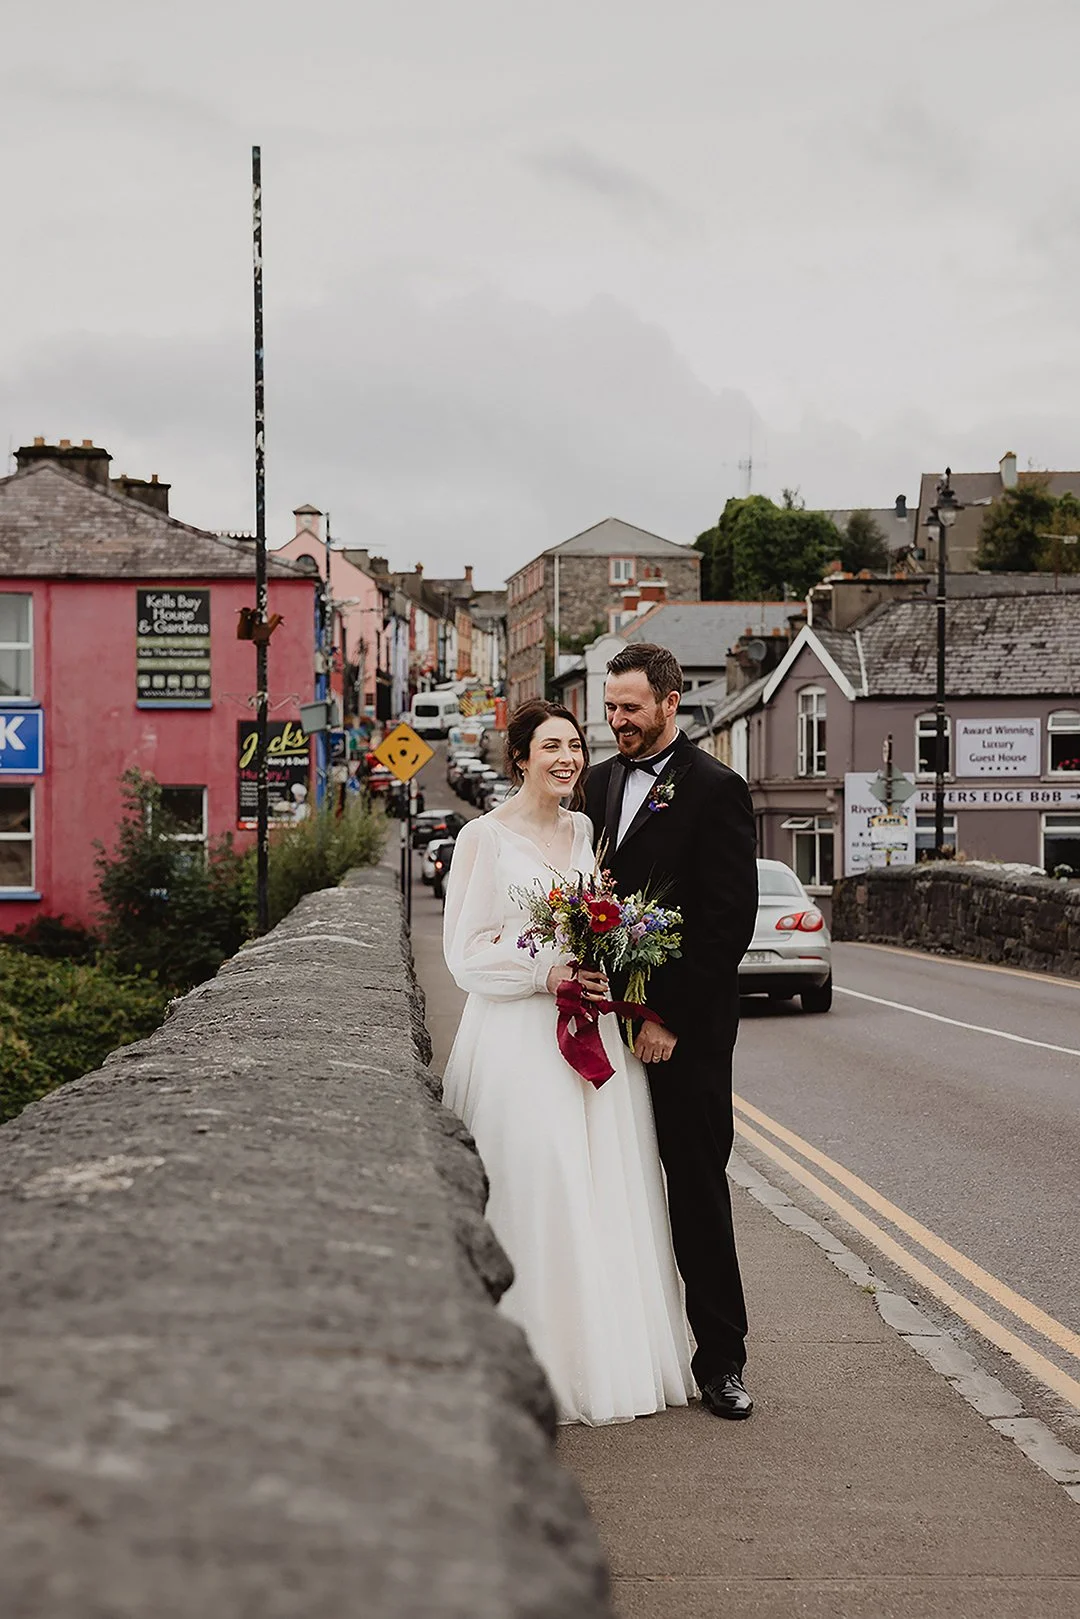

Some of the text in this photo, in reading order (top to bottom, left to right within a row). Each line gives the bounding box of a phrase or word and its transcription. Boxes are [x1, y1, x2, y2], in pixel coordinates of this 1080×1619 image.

[146, 594, 202, 612] Kells Bay
[153, 608, 195, 621] House
[139, 619, 209, 634] & Gardens
[963, 725, 1034, 737] Award Winning
[239, 721, 309, 768] Jcks
[983, 740, 1014, 750] Luxury
[969, 753, 1027, 762] Guest House
[983, 791, 1024, 803] EDGE
[1030, 791, 1062, 803] B&B
[851, 805, 884, 814] Rivers
